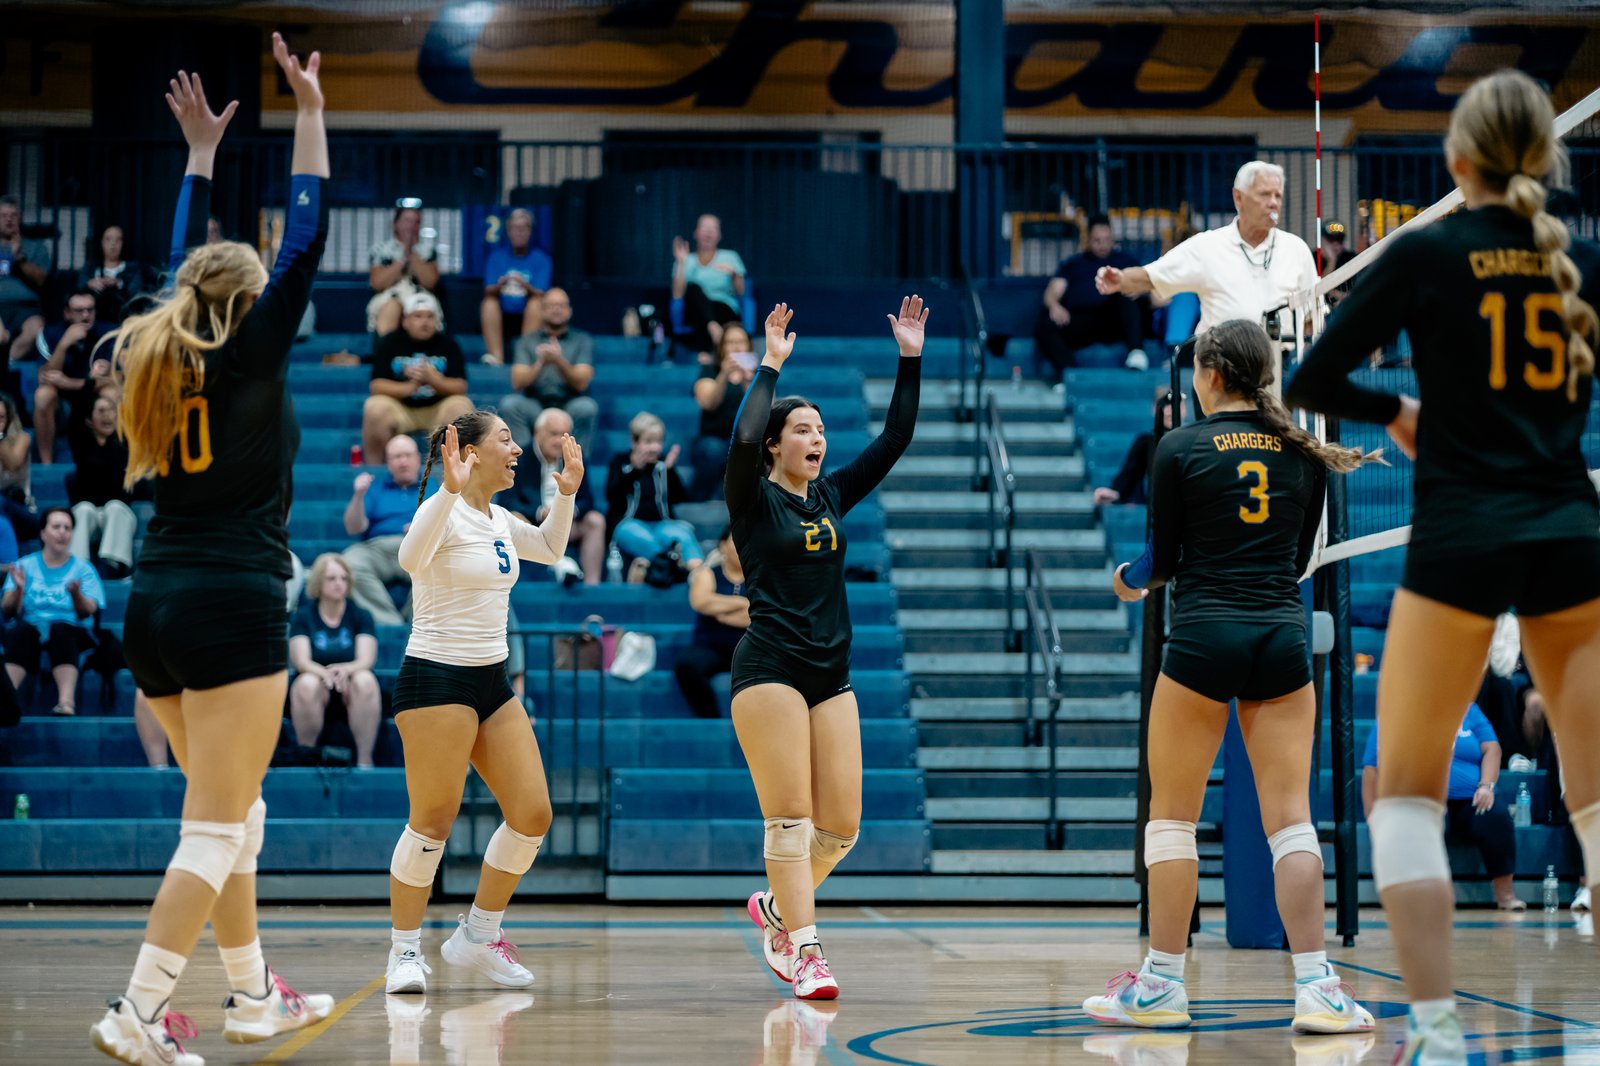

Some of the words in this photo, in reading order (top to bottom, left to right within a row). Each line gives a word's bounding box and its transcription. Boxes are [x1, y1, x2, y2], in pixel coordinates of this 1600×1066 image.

[485, 214, 500, 243] 2
[1479, 292, 1566, 390] 15
[1213, 432, 1282, 453] CHARGERS
[1236, 460, 1270, 524] 3
[800, 517, 837, 551] 21
